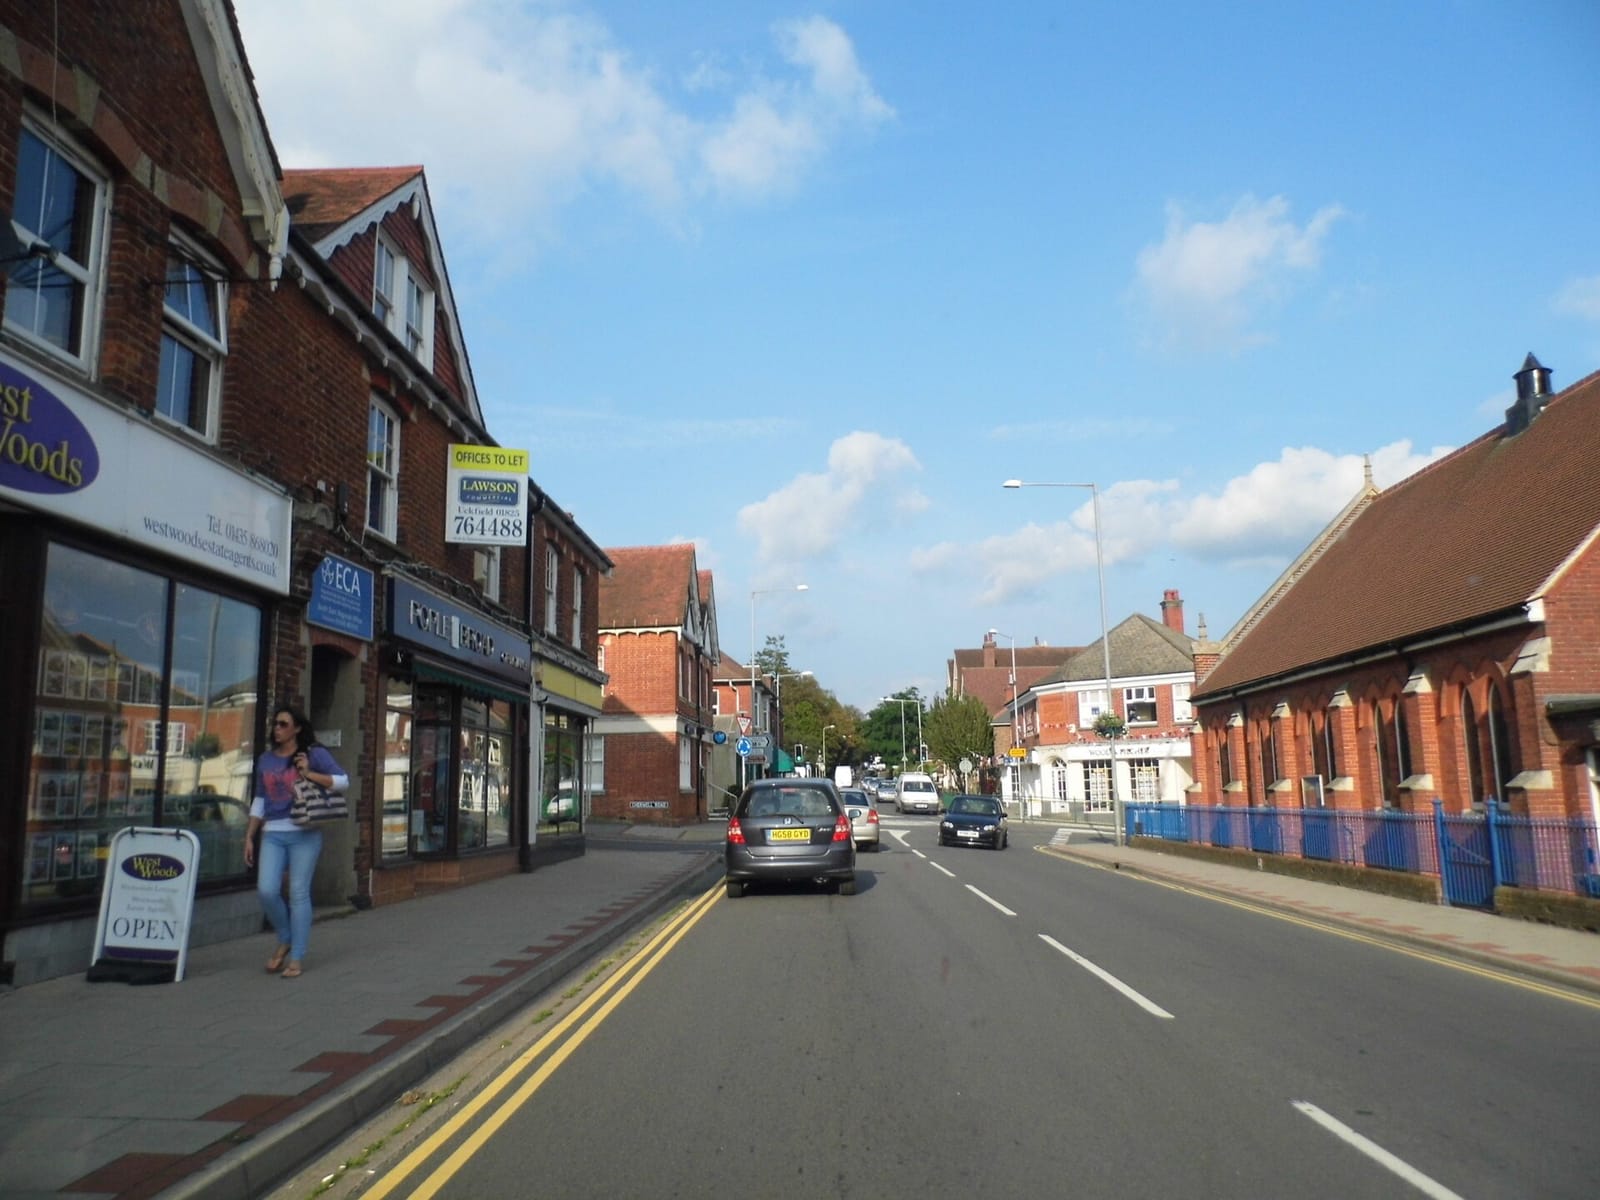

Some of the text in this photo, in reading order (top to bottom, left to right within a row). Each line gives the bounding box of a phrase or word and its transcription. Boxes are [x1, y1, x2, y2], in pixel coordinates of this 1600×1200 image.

[456, 451, 524, 466] OFFICES TO LET
[463, 480, 517, 493] LAWSON
[458, 506, 494, 515] Uckfield
[454, 515, 523, 538] 764488
[335, 562, 361, 597] ECA
[134, 857, 161, 870] West
[140, 862, 178, 878] Woods
[113, 917, 178, 940] OPEN
